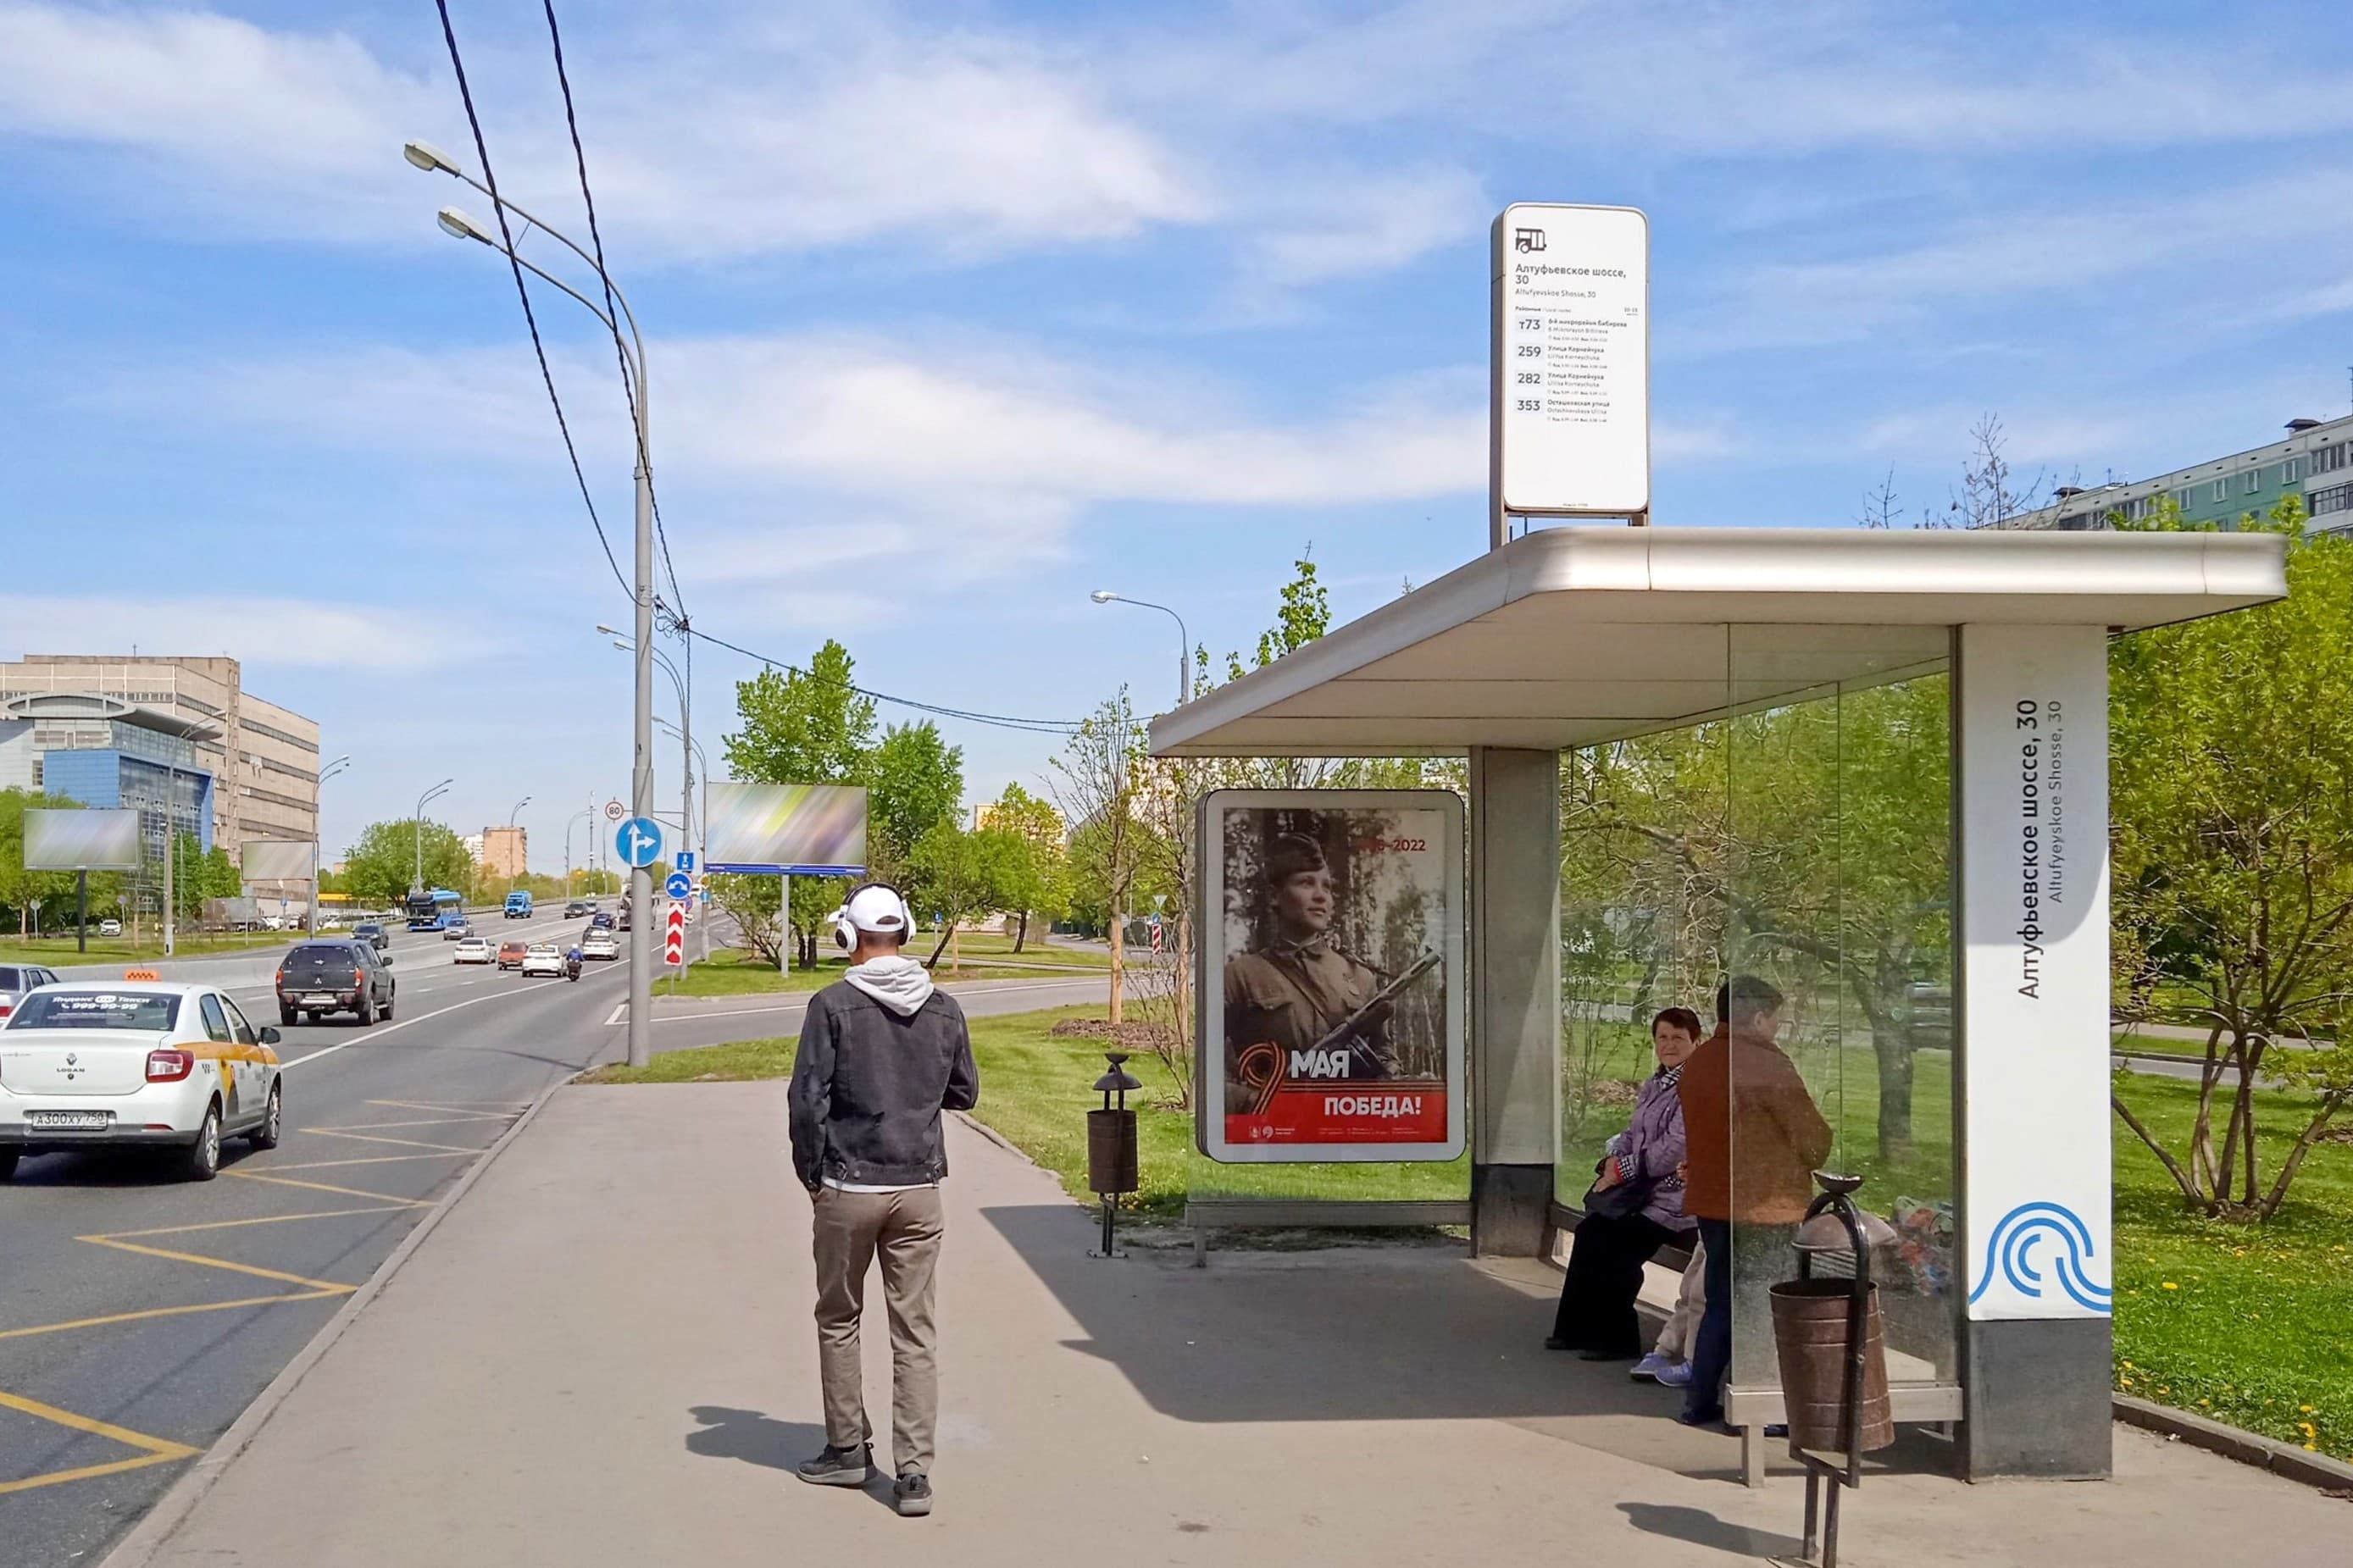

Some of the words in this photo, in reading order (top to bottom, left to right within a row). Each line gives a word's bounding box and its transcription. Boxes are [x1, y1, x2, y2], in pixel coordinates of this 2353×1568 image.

[1515, 263, 1590, 275] Алтуфьевское
[1592, 269, 1627, 278] шоссе,
[1515, 274, 1529, 285] 30
[1518, 345, 1541, 357] 259
[1518, 373, 1540, 384] 282
[1517, 400, 1540, 411] 353
[2017, 700, 2038, 730] 30
[2047, 701, 2062, 723] 30
[2047, 729, 2064, 790] Shosse,
[2023, 738, 2042, 817] шоссе,
[609, 806, 620, 815] 80
[2017, 826, 2044, 1000] Алтуфьевское
[1290, 1050, 1350, 1078] МАЯ
[1324, 1096, 1422, 1117] ПОБЕДА!
[86, 1111, 103, 1122] 750
